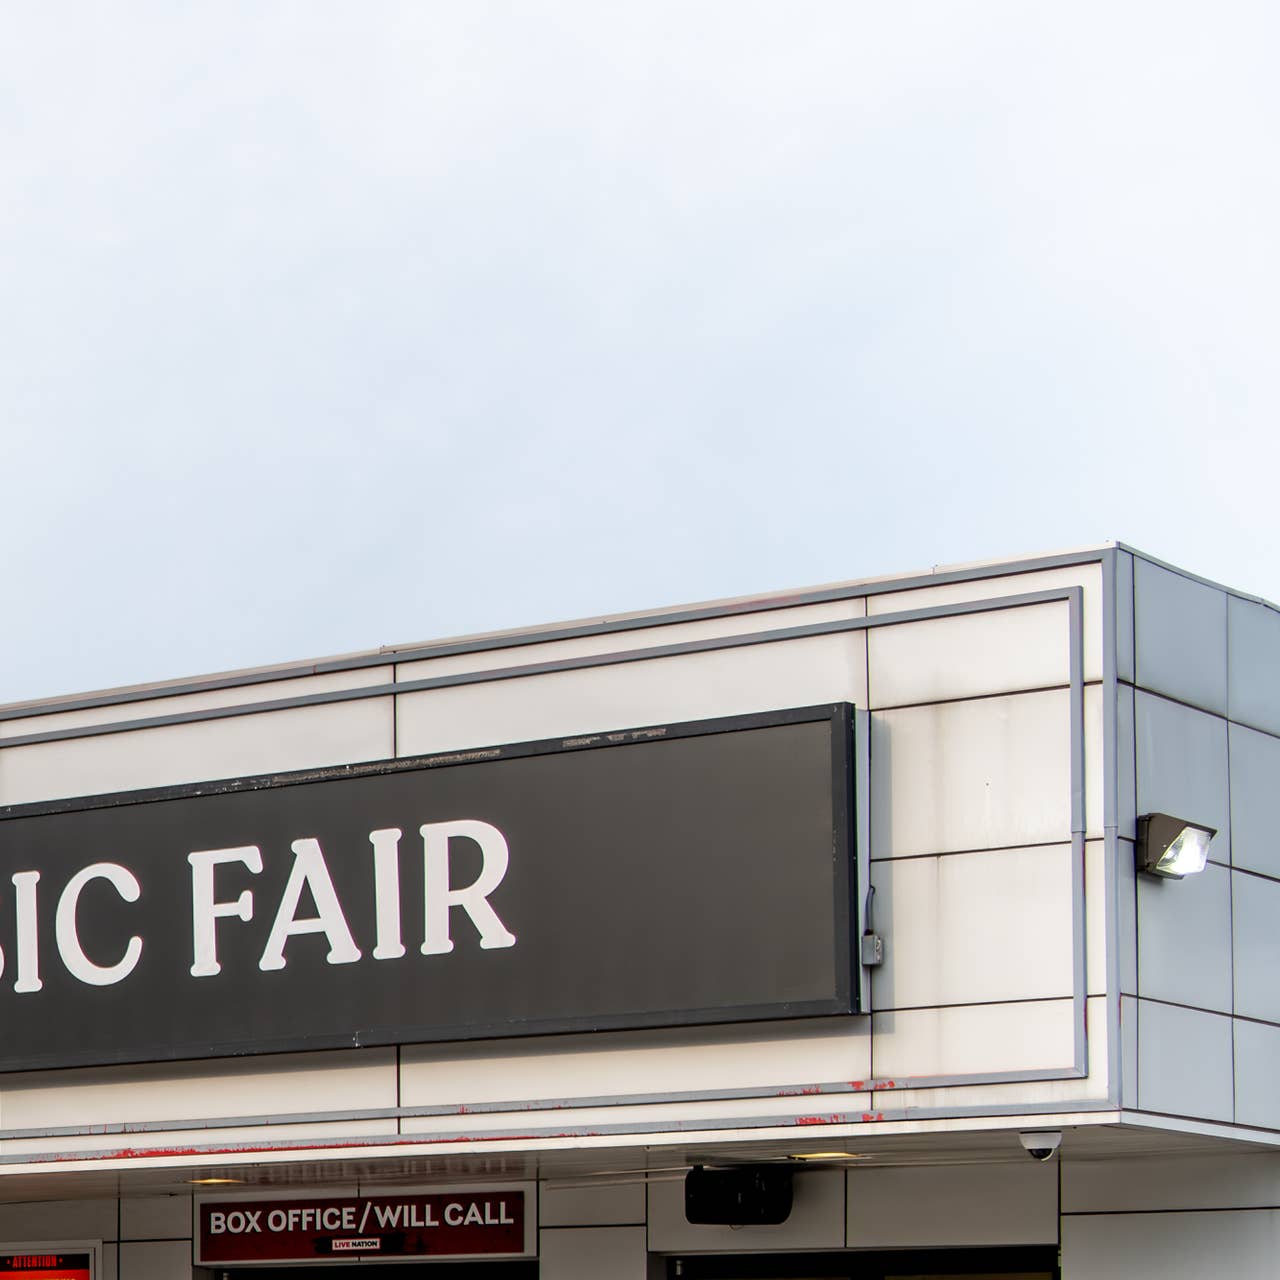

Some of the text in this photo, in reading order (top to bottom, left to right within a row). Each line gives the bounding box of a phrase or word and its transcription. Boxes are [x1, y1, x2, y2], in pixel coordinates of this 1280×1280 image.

[188, 819, 515, 975] FAIR
[210, 1211, 262, 1234] BOX
[444, 1202, 514, 1226] CALL
[351, 1239, 378, 1247] NATION
[12, 1256, 58, 1268] ATTENTION
